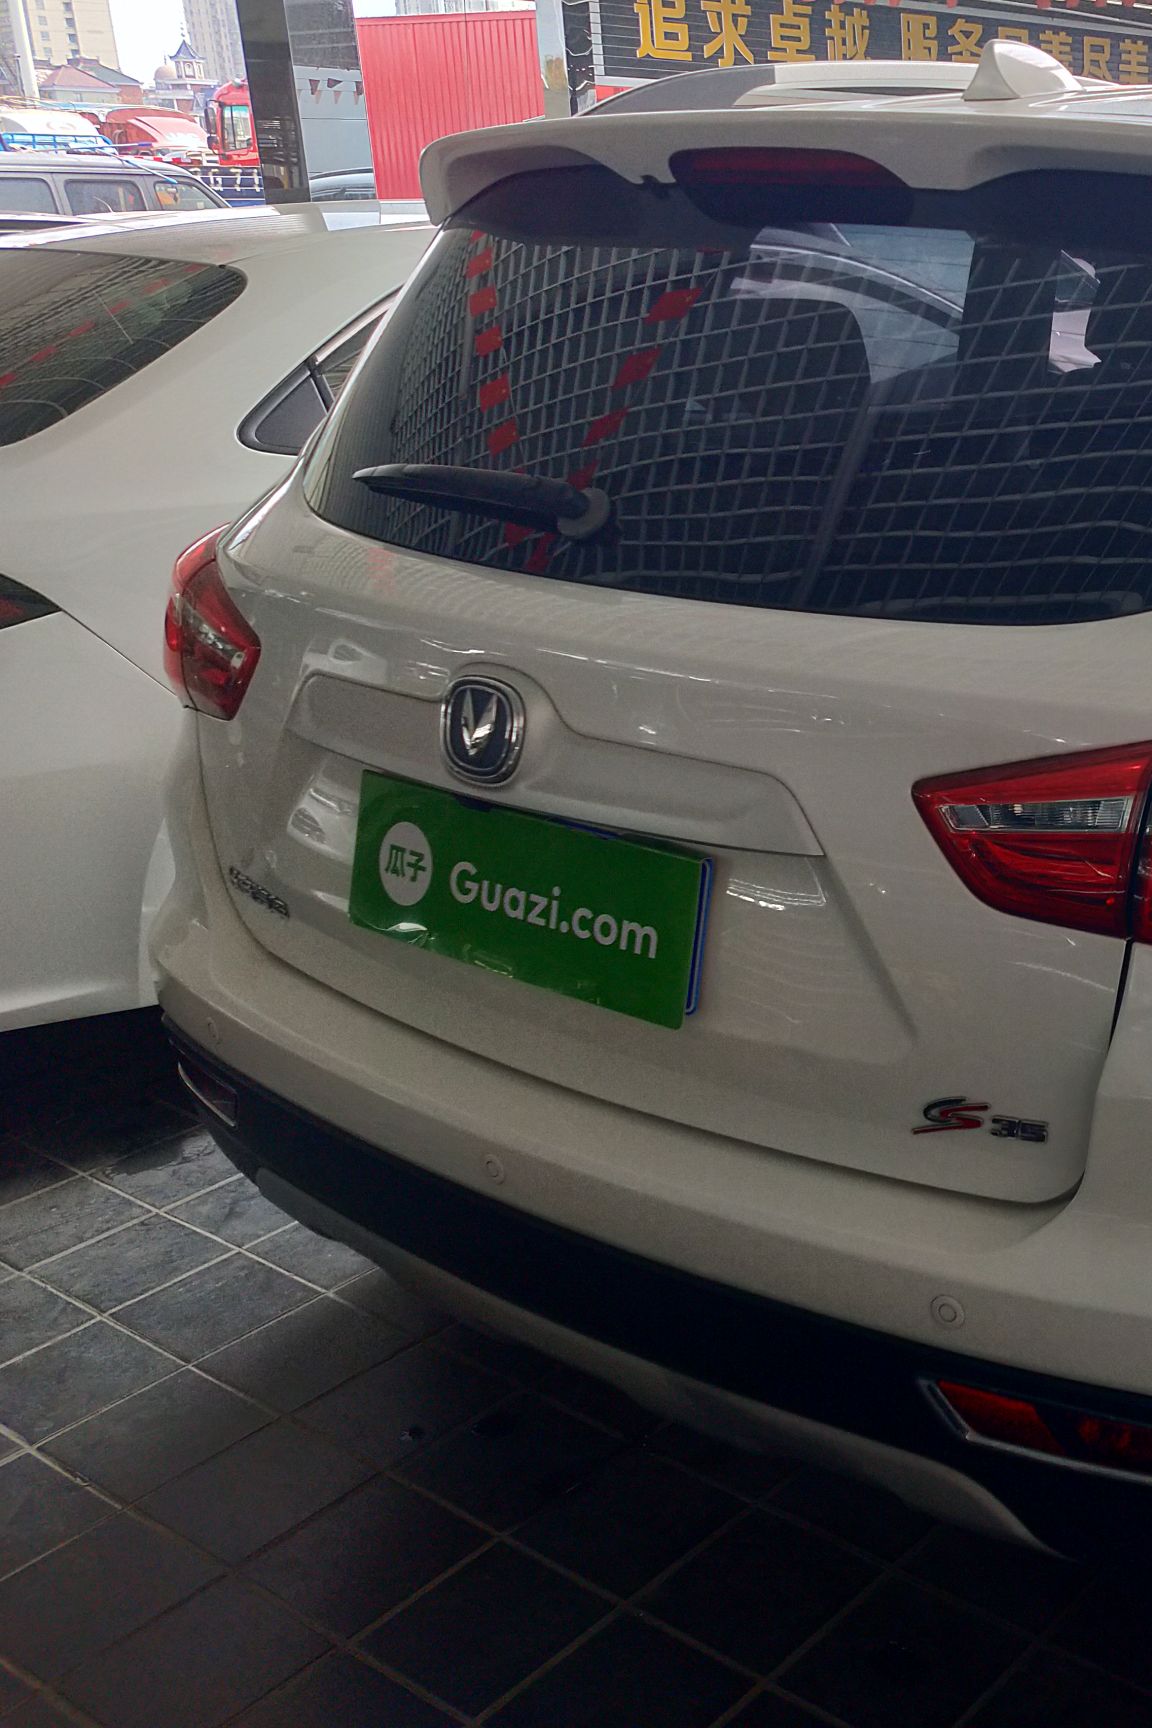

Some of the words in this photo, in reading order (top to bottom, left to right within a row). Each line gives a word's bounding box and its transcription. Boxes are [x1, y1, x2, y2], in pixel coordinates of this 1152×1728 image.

[634, 0, 871, 67] 追求卓越
[385, 844, 427, 883] 瓜子
[449, 861, 658, 959] Guazi.com
